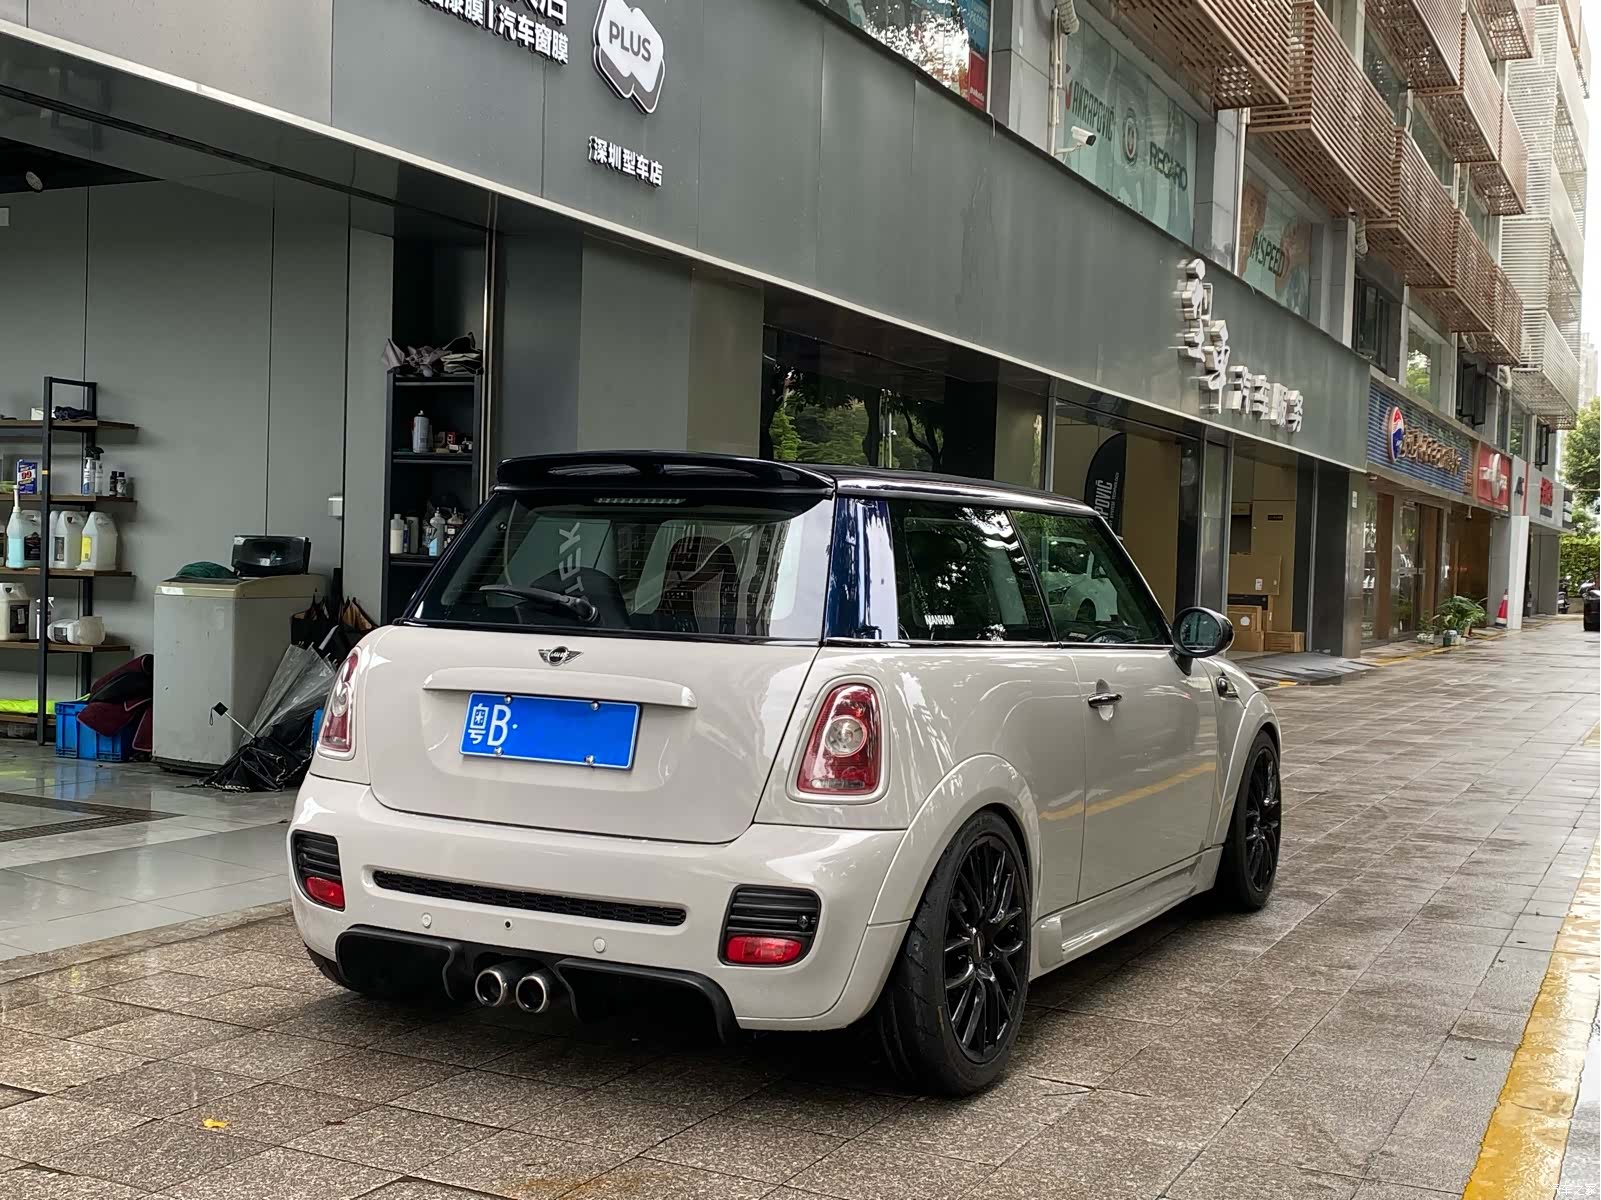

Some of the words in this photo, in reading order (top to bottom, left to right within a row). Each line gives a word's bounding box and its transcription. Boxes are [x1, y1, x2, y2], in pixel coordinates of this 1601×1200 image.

[608, 20, 652, 62] PLUS
[589, 136, 663, 186] 深圳型车店
[1149, 141, 1188, 191] RECARO
